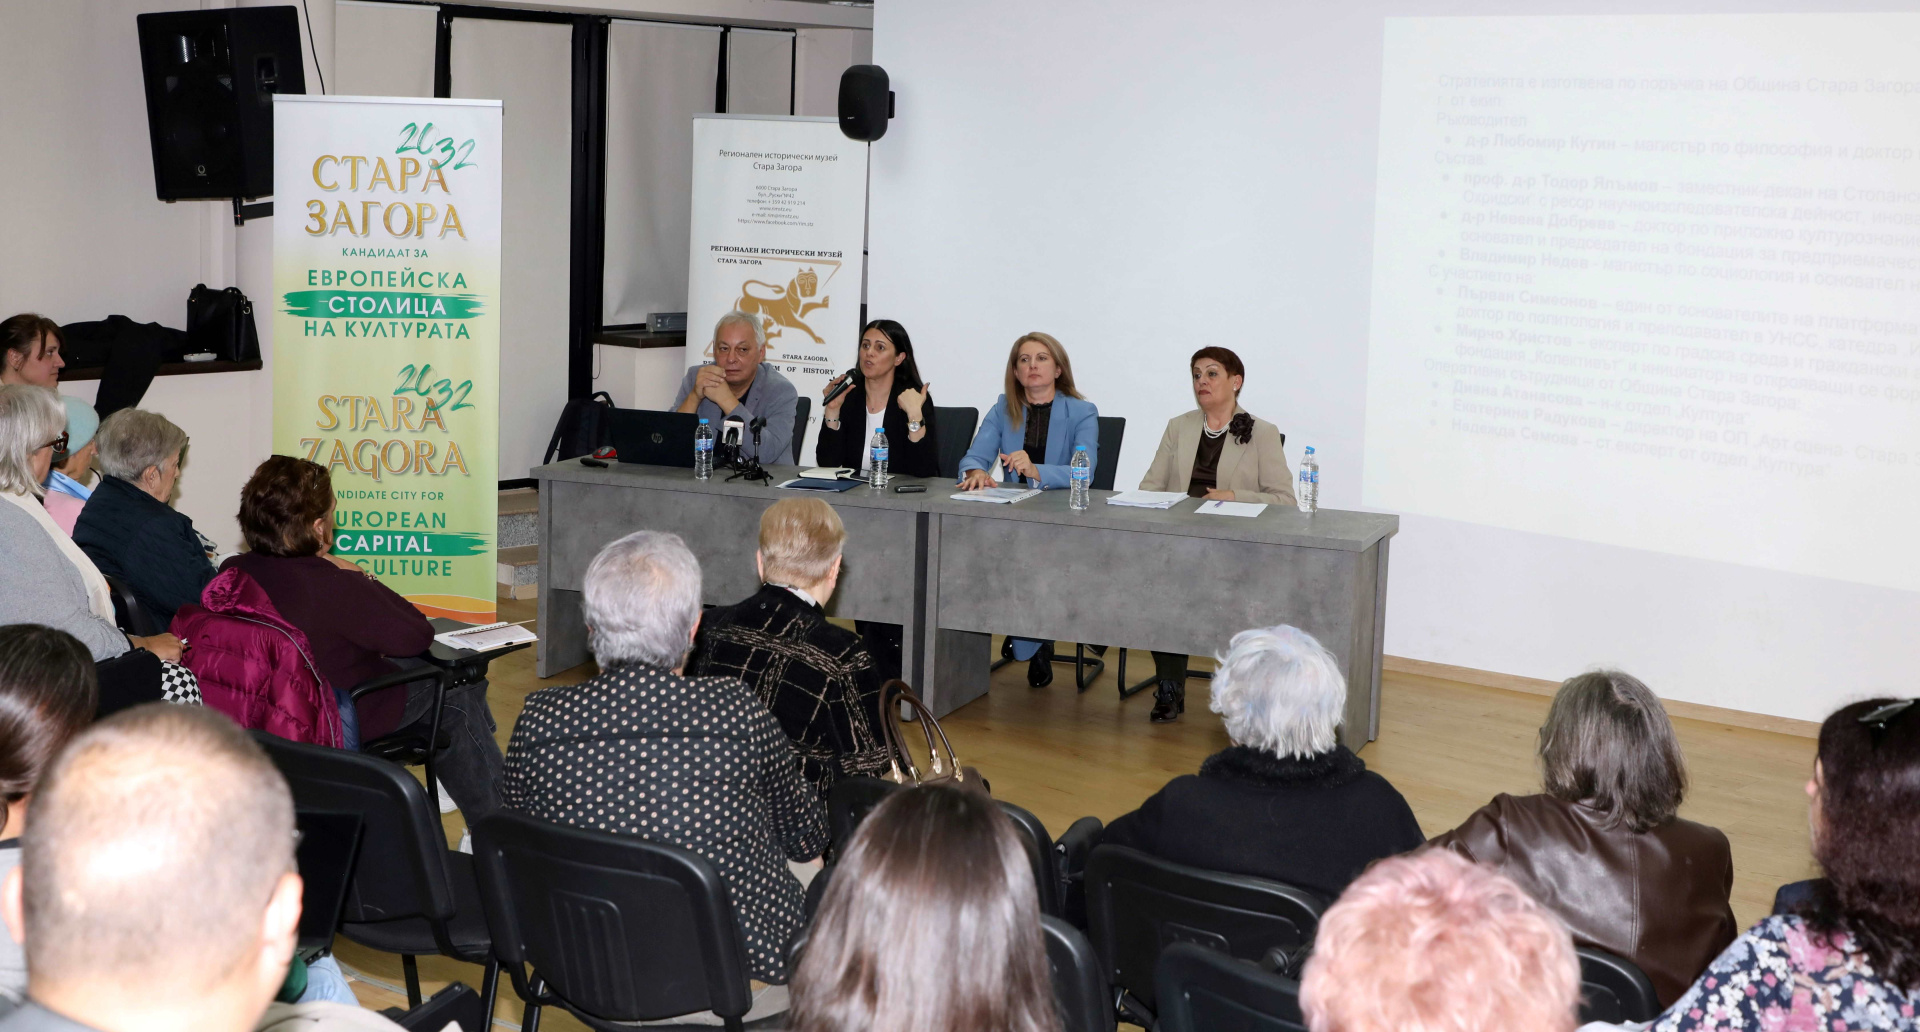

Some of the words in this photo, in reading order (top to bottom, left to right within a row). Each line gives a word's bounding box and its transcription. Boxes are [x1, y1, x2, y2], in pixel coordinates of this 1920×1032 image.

[395, 122, 478, 170] 2032
[719, 149, 763, 158] Регионален
[764, 151, 814, 161] исторически
[815, 154, 838, 162] музей
[312, 154, 451, 193] СТАРА
[752, 162, 775, 171] Стара
[776, 163, 803, 172] Загора
[304, 199, 468, 239] ЗАГОРА
[342, 247, 410, 258] КАНДИДАТ
[414, 249, 428, 258] ЗА
[710, 245, 759, 254] РЕГИОНАЛЕН
[760, 247, 816, 257] ИСТОРИЧЕСКИ
[817, 250, 843, 258] МУЗЕЙ
[738, 258, 762, 266] ЗАГОРА
[308, 267, 468, 289] ЕВРОПЕЙСКА
[328, 296, 447, 317] СТОЛИЦА
[304, 320, 336, 337] НА
[345, 321, 471, 339] КУЛТУРАТА
[802, 367, 835, 376] HISTORY
[393, 363, 476, 412] 2032
[315, 394, 446, 431] STARA
[300, 438, 469, 481] ZAGORA
[337, 490, 387, 500] NDIDATE
[391, 491, 417, 500] CITY
[421, 491, 444, 500] FOR
[335, 511, 446, 529] UROPEAN
[335, 534, 433, 552] CAPITAL
